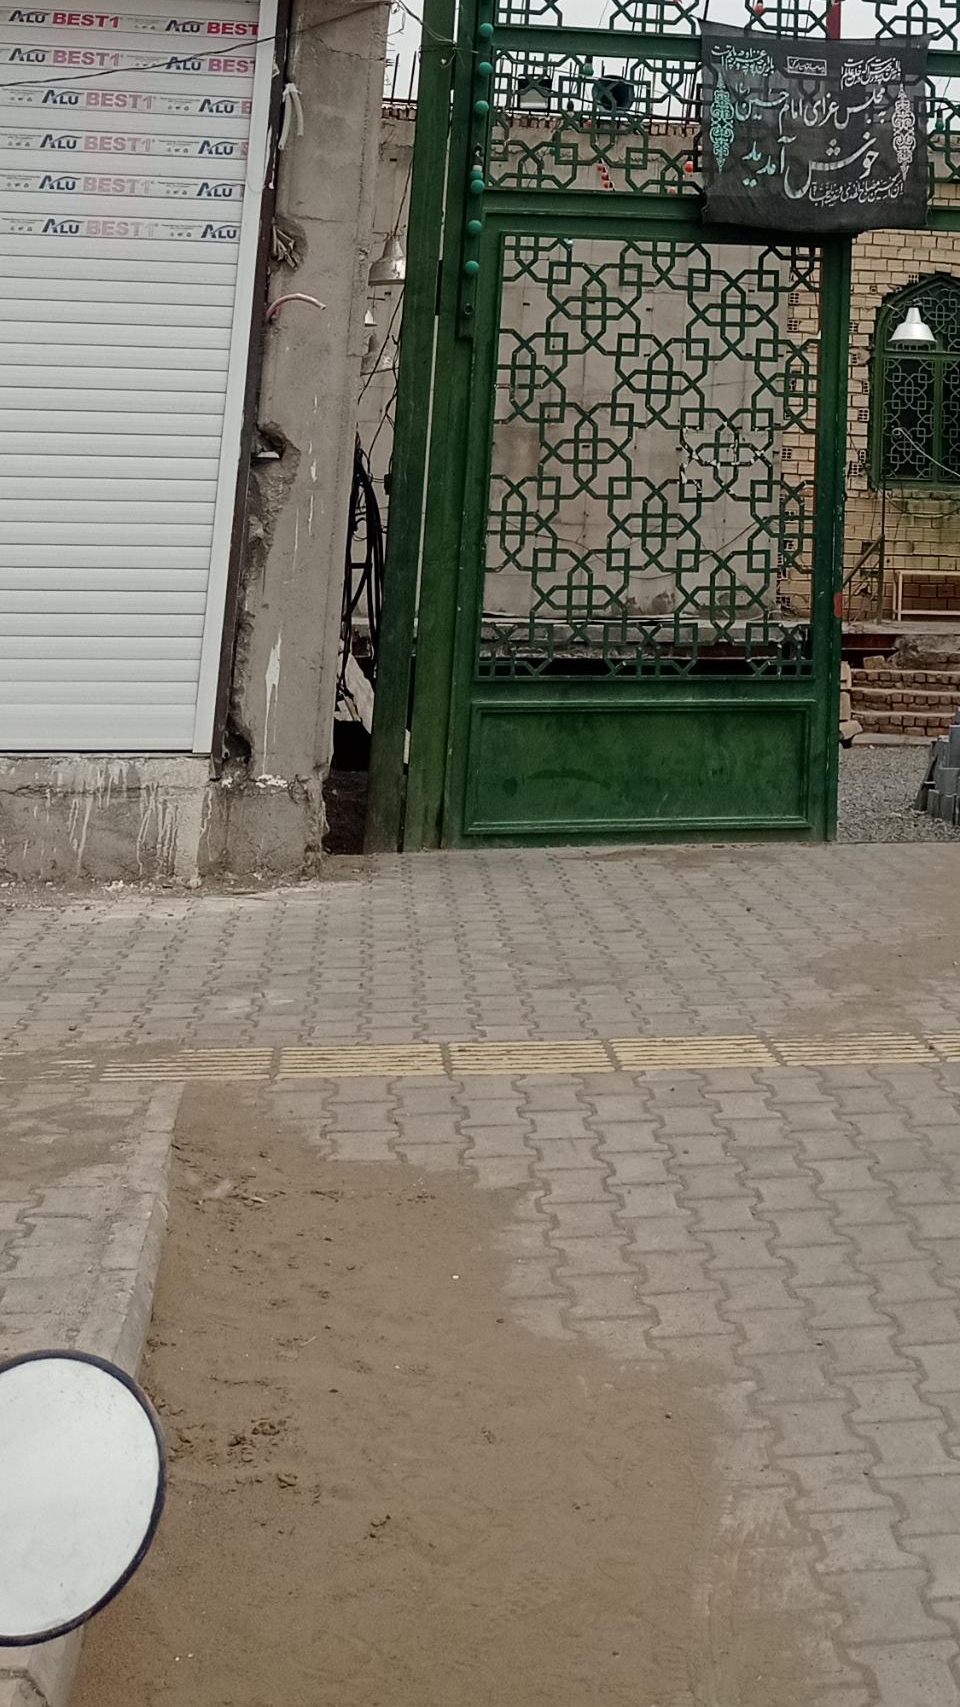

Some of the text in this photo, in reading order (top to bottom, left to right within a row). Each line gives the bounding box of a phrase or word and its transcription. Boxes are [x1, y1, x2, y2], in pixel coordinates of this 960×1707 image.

[52, 11, 121, 29] BEST1
[52, 49, 121, 67] BEST1
[85, 91, 153, 110] BEST1
[735, 90, 790, 122] حسین
[778, 97, 803, 135] امام
[84, 135, 152, 153] BEST1
[742, 132, 881, 200] خوش آمدید
[82, 176, 152, 195] BEST1
